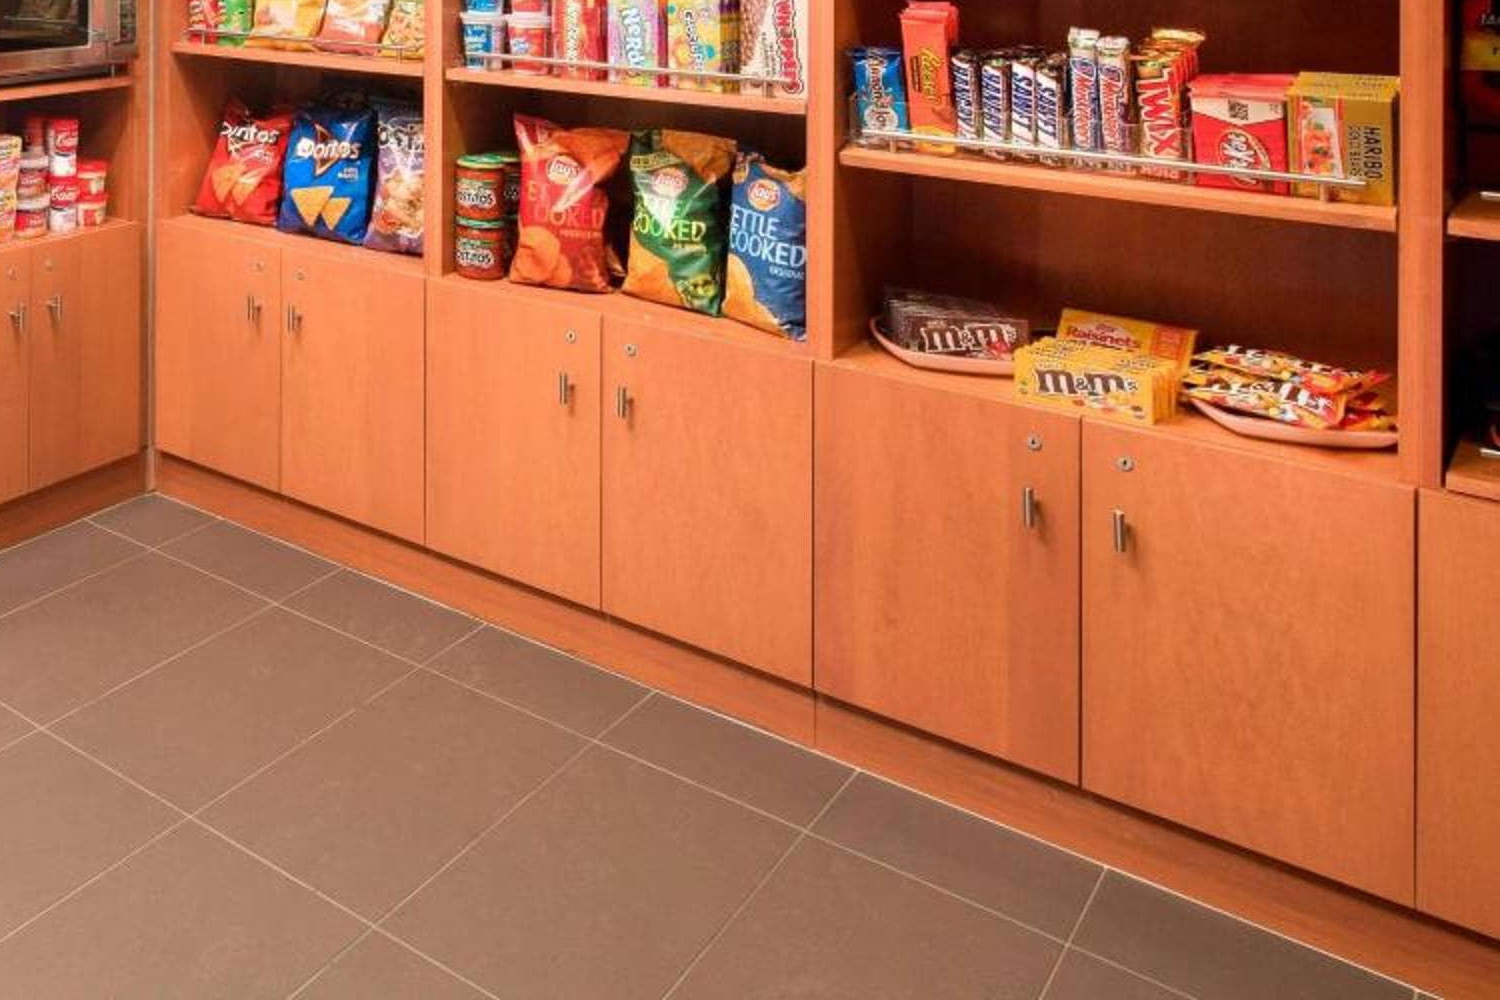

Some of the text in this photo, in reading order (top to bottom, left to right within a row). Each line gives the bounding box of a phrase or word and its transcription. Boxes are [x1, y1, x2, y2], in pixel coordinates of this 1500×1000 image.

[1137, 66, 1181, 158] TWIX
[296, 136, 362, 160] Doritos
[1364, 126, 1382, 180] HARIBO
[731, 203, 779, 240] ETTLE
[729, 229, 806, 268] COOKED
